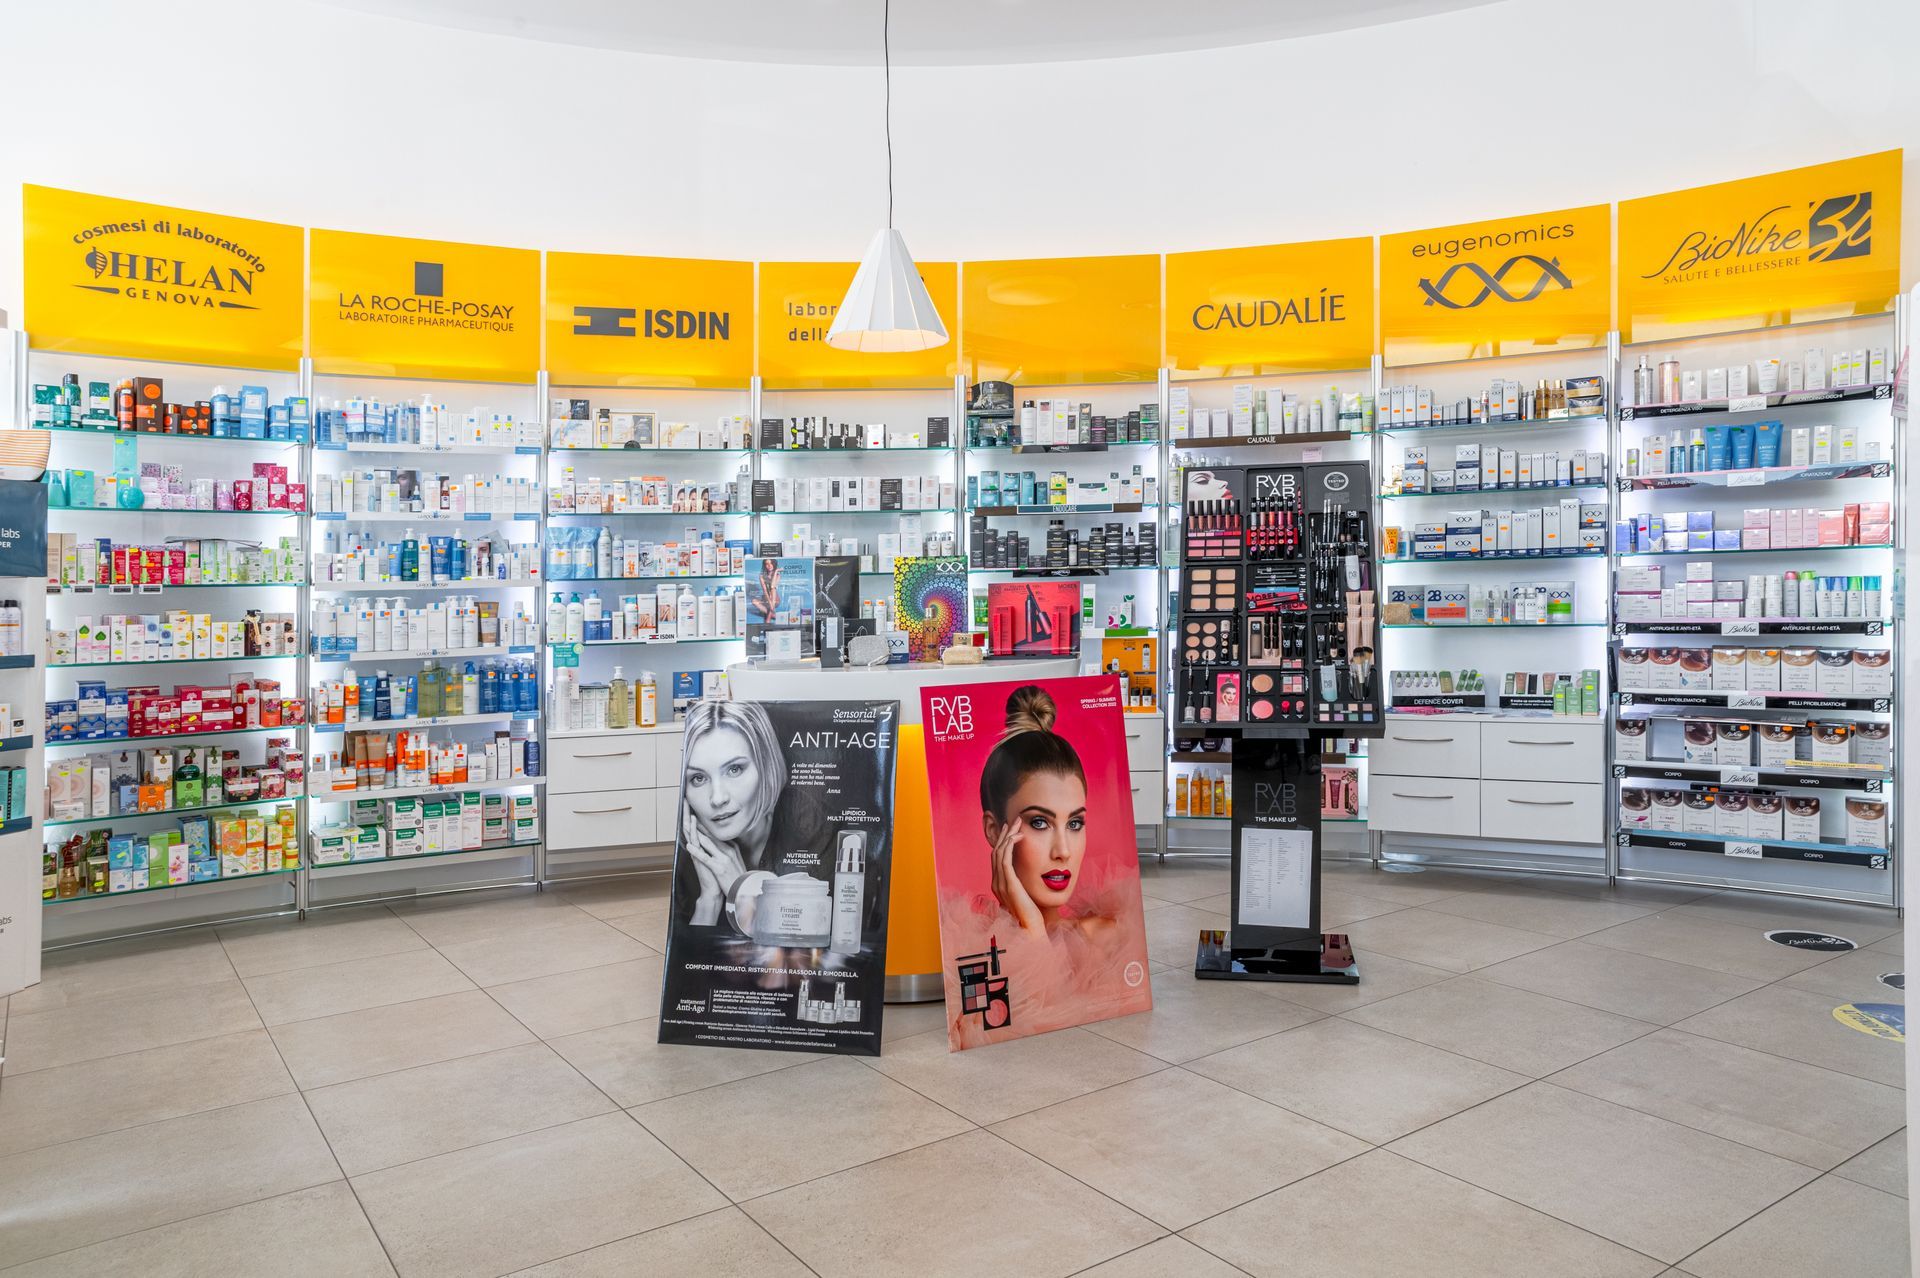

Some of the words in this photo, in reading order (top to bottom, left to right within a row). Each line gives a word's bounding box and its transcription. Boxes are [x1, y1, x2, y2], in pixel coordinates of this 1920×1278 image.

[72, 219, 146, 246] cosmesi
[153, 219, 170, 234] di
[177, 223, 266, 276] laboratorio
[1412, 223, 1576, 260] eugenomics
[1641, 205, 1802, 280] BioNike
[107, 250, 254, 296] HELAN
[1663, 268, 1710, 286] SALUTE
[1714, 267, 1721, 278] E
[1726, 256, 1802, 278] BELLESSERE
[125, 287, 215, 308] GENOVA
[339, 292, 364, 310] LA
[370, 295, 514, 320] ROCHE-POSAY
[789, 303, 838, 316] labor
[1192, 288, 1346, 331] CAUDALÍE
[339, 310, 414, 326] LABORATOIRE
[417, 316, 514, 334] PHARMACEUTIQUE
[644, 309, 730, 340] ISDIN
[1256, 474, 1296, 488] RVB
[1256, 487, 1296, 500] LAB
[1, 527, 20, 539] labs
[1392, 590, 1406, 602] 28
[1428, 590, 1442, 602] 28
[833, 708, 876, 719] Sensorial
[930, 695, 972, 716] RVB
[933, 714, 974, 735] LAB
[789, 732, 892, 749] ANTI-AGE
[948, 734, 965, 742] MAKE
[1255, 783, 1297, 800] RVB
[1255, 798, 1297, 814] LAB
[780, 906, 803, 914] Firming
[748, 967, 788, 975] RISTRUTTURA
[788, 968, 817, 976] RASSODA
[823, 970, 859, 978] RIMODELLA.
[676, 1004, 705, 1014] Anti-Age
